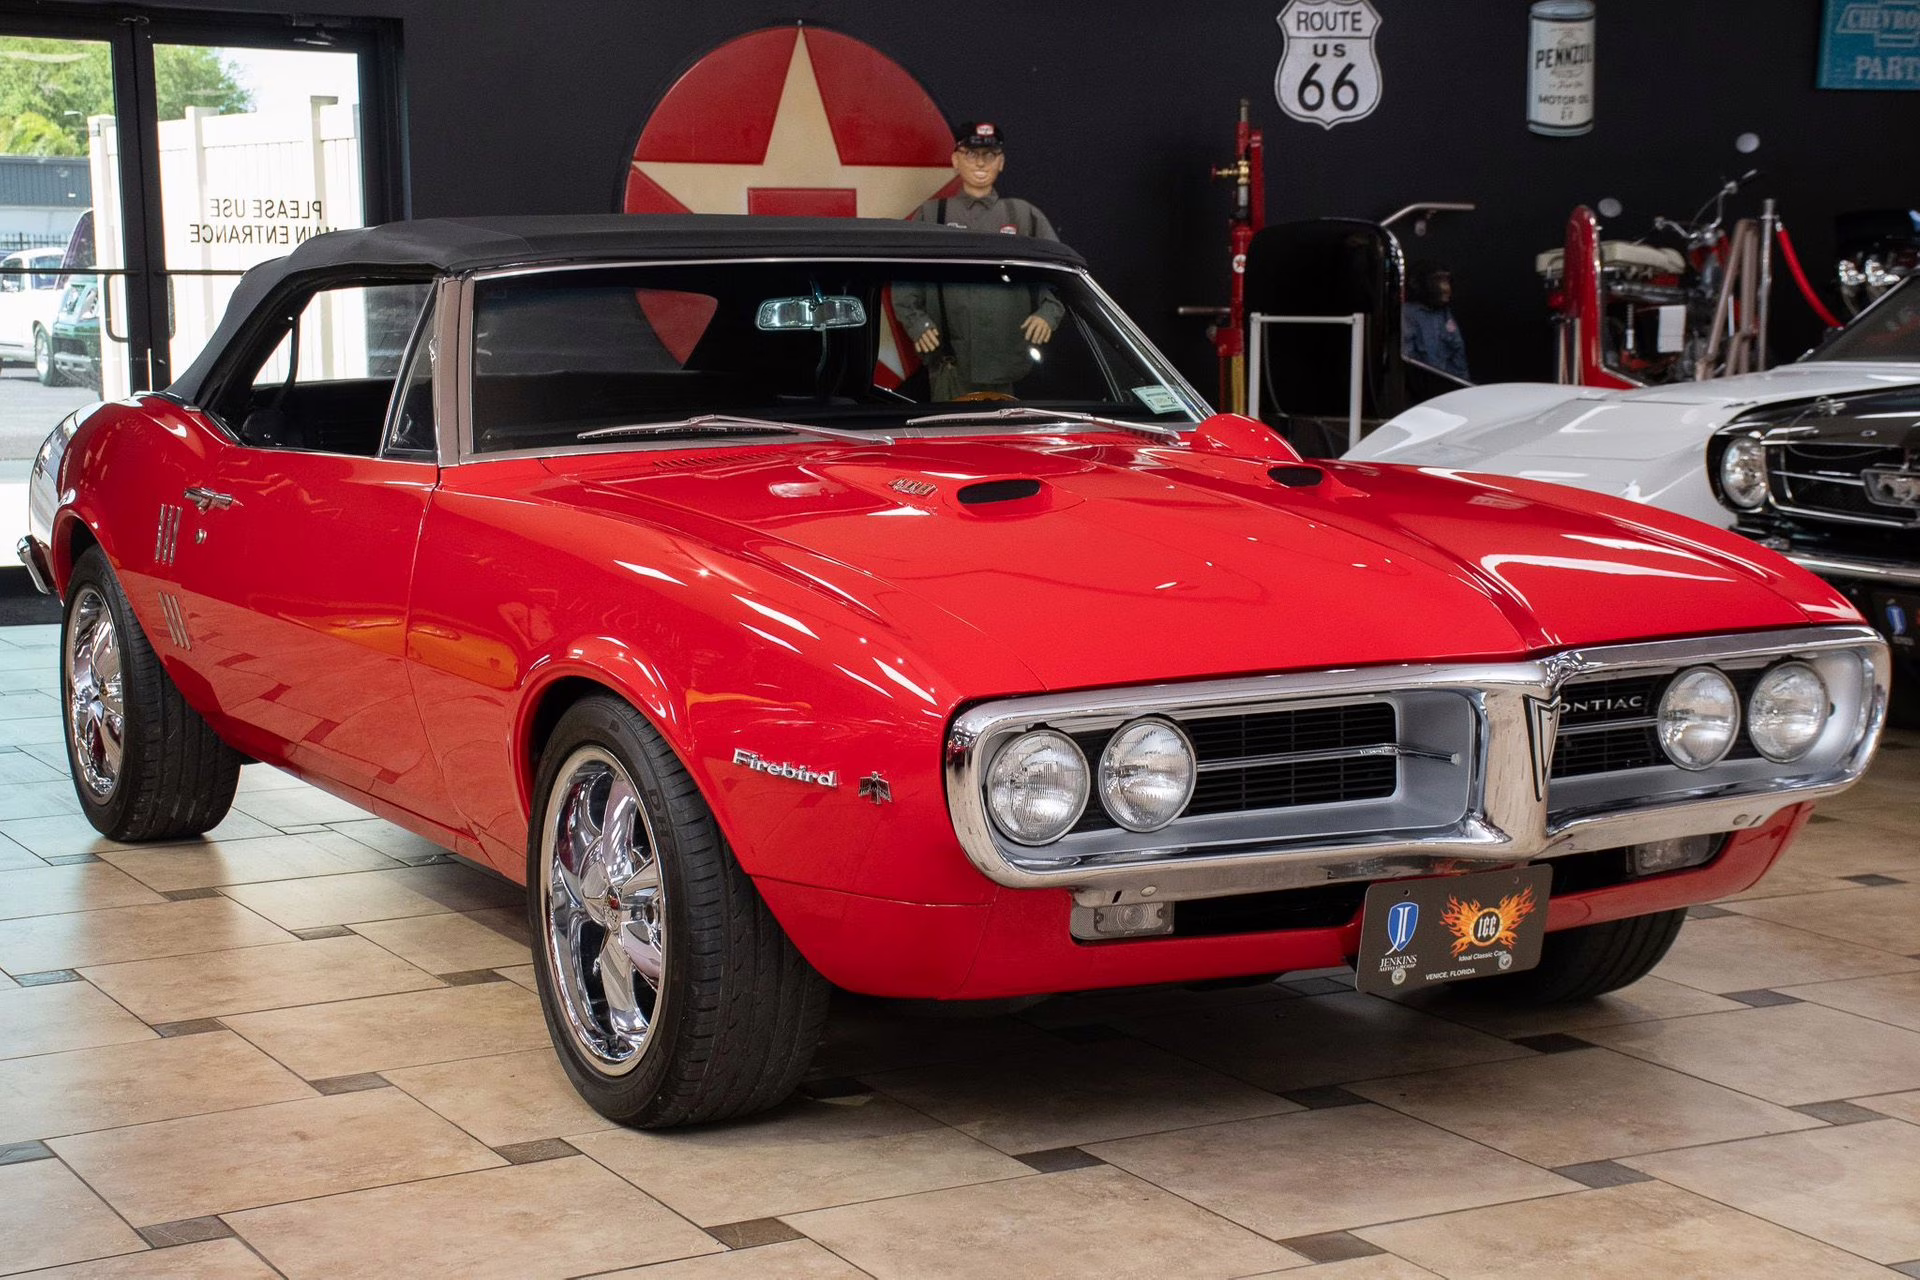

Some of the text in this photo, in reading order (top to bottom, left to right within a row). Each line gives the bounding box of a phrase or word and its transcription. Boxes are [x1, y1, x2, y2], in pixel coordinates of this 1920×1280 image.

[1296, 10, 1362, 32] ROUTE
[1298, 61, 1359, 112] 66
[1560, 695, 1643, 714] ONTIAC
[732, 747, 838, 788] Firebird
[1379, 954, 1418, 968] JENKINS
[1458, 954, 1473, 962] Ideal
[1473, 951, 1493, 960] Classic
[1425, 967, 1476, 980] VENICE, FLORIDA
